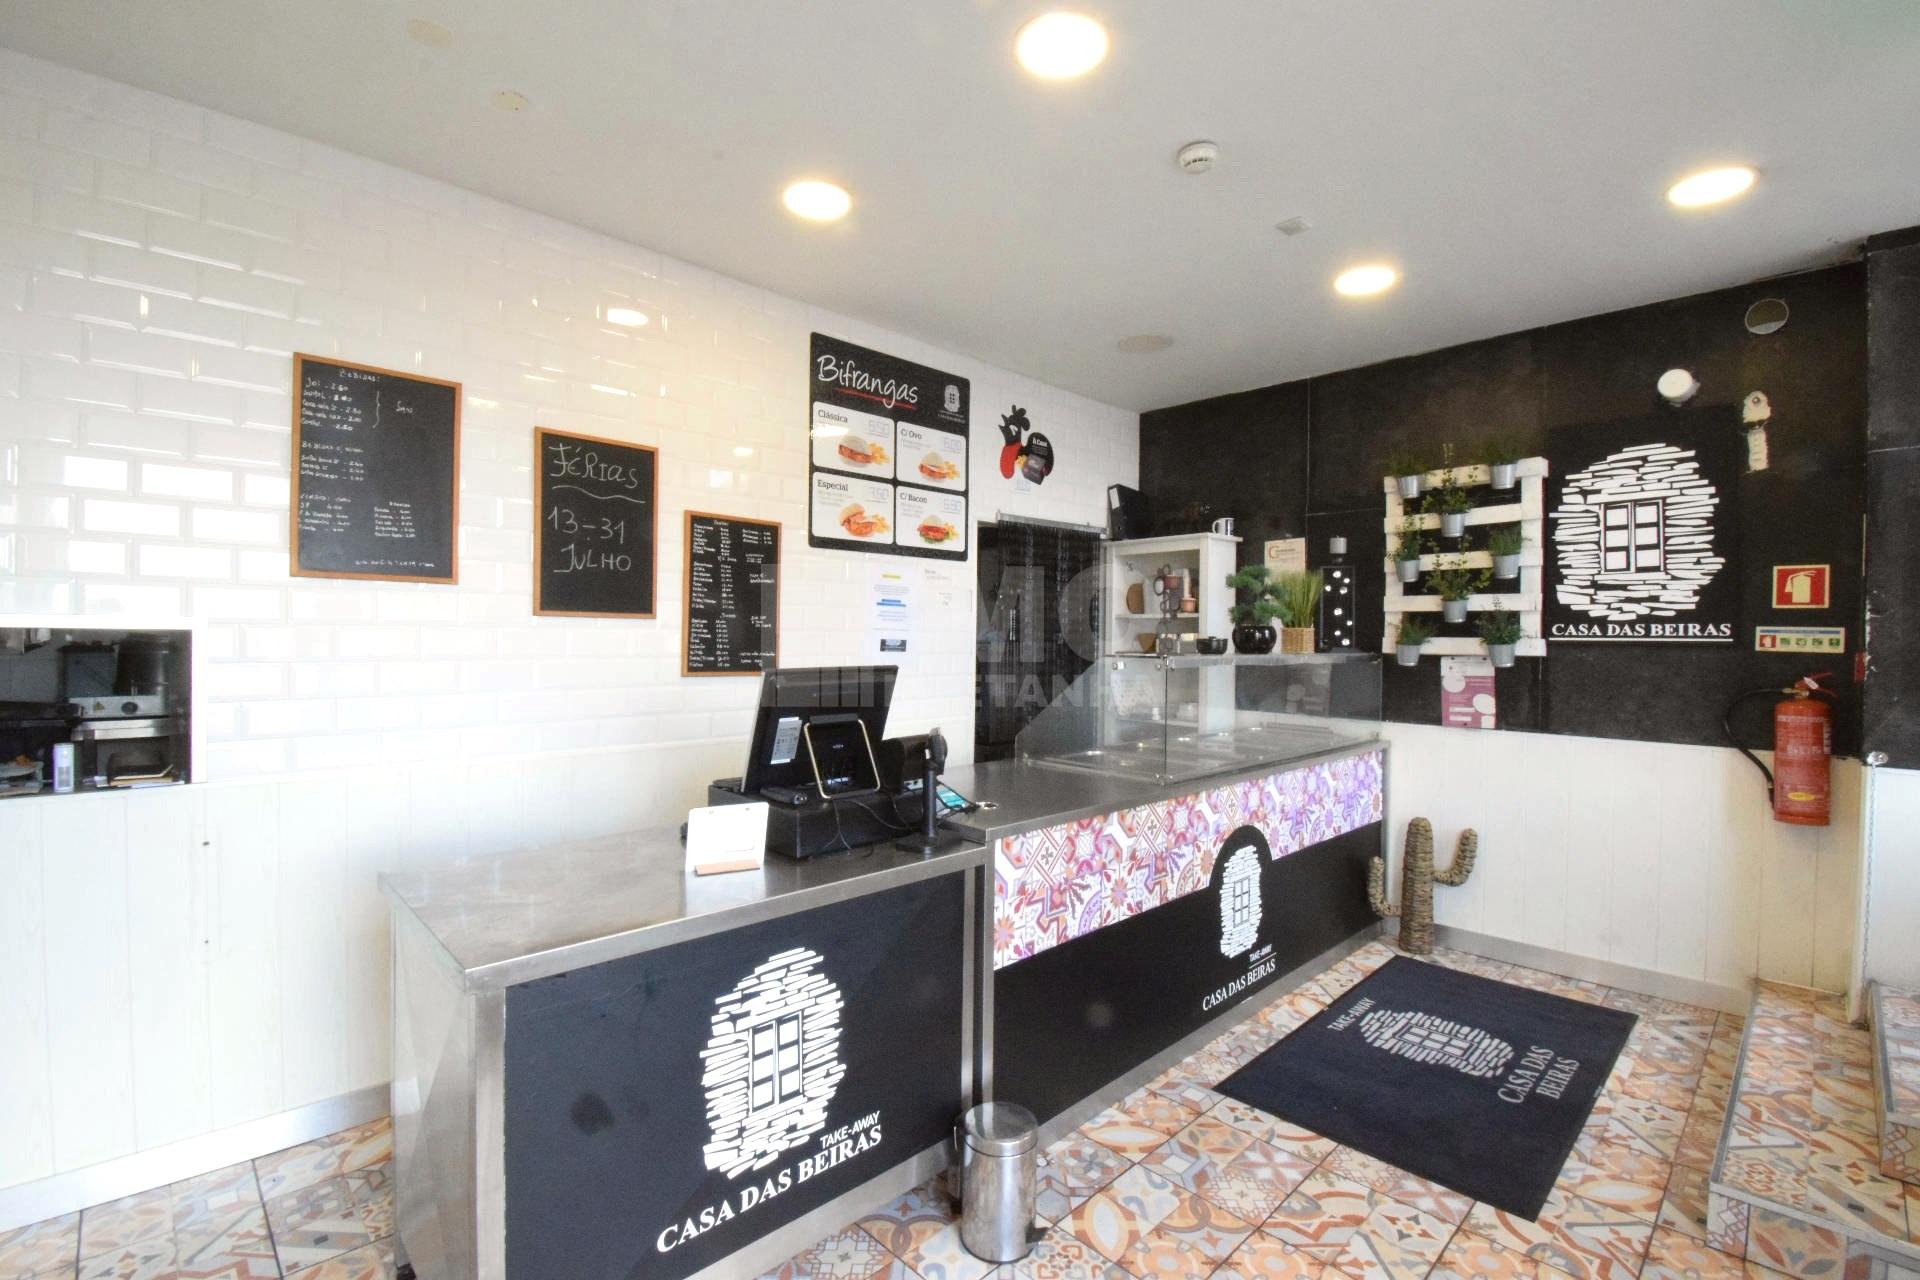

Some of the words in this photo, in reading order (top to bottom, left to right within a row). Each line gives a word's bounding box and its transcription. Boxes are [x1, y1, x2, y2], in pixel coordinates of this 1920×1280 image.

[817, 354, 919, 409] Bifrangas
[817, 409, 848, 423] Clássica
[908, 430, 922, 440] Ovo
[817, 479, 849, 493] Especial
[908, 494, 928, 504] Bacon
[1551, 622, 1602, 637] CASA
[1606, 622, 1646, 637] DAS
[1649, 622, 1732, 637] BEIRAS
[1202, 986, 1227, 1012] CASA
[1228, 975, 1246, 996] DAS
[1247, 958, 1276, 986] BEIRAS
[1326, 997, 1376, 1032] TAKE-AWAY
[1497, 1069, 1540, 1103] CASA
[1520, 1045, 1555, 1070] DAS
[1535, 1056, 1580, 1100] BEIRAS
[819, 1110, 880, 1149] TAKE-AWAY
[656, 1199, 736, 1253] CASA
[740, 1168, 792, 1214] DAS
[797, 1124, 882, 1184] BEIRAS
